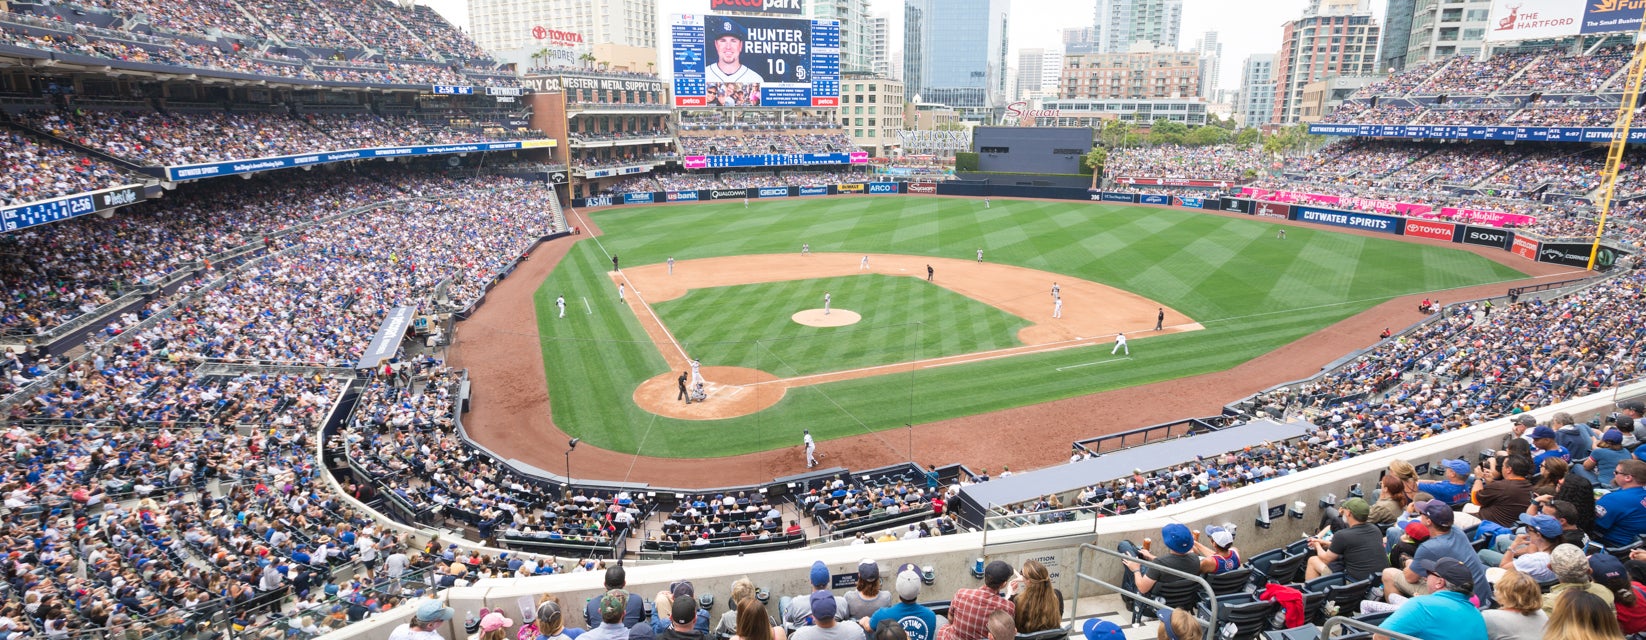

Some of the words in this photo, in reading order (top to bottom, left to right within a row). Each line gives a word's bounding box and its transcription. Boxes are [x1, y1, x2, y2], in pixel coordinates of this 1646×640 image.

[763, 0, 800, 10] park
[1517, 18, 1574, 30] HARTFORD
[548, 29, 583, 43] TOYOTA
[747, 28, 802, 42] HUNTER
[744, 41, 806, 54] RENFROE
[766, 59, 785, 75] 10
[562, 78, 598, 89] WESTERN
[601, 80, 624, 90] METAL
[626, 82, 649, 91] SUPPLY
[652, 82, 662, 91] CO.
[1008, 102, 1060, 120] Sycuan
[712, 190, 746, 198] QUALCOMM
[71, 198, 91, 212] 2:56
[587, 198, 611, 206] ASML
[1376, 200, 1397, 210] DECK
[4, 210, 18, 219] CHC
[62, 207, 68, 216] 4
[6, 221, 17, 230] SD
[1304, 211, 1347, 224] CUTWATER
[1350, 216, 1387, 229] SPIRITS
[1419, 225, 1452, 236] TOYOTA
[1470, 232, 1504, 241] SONY
